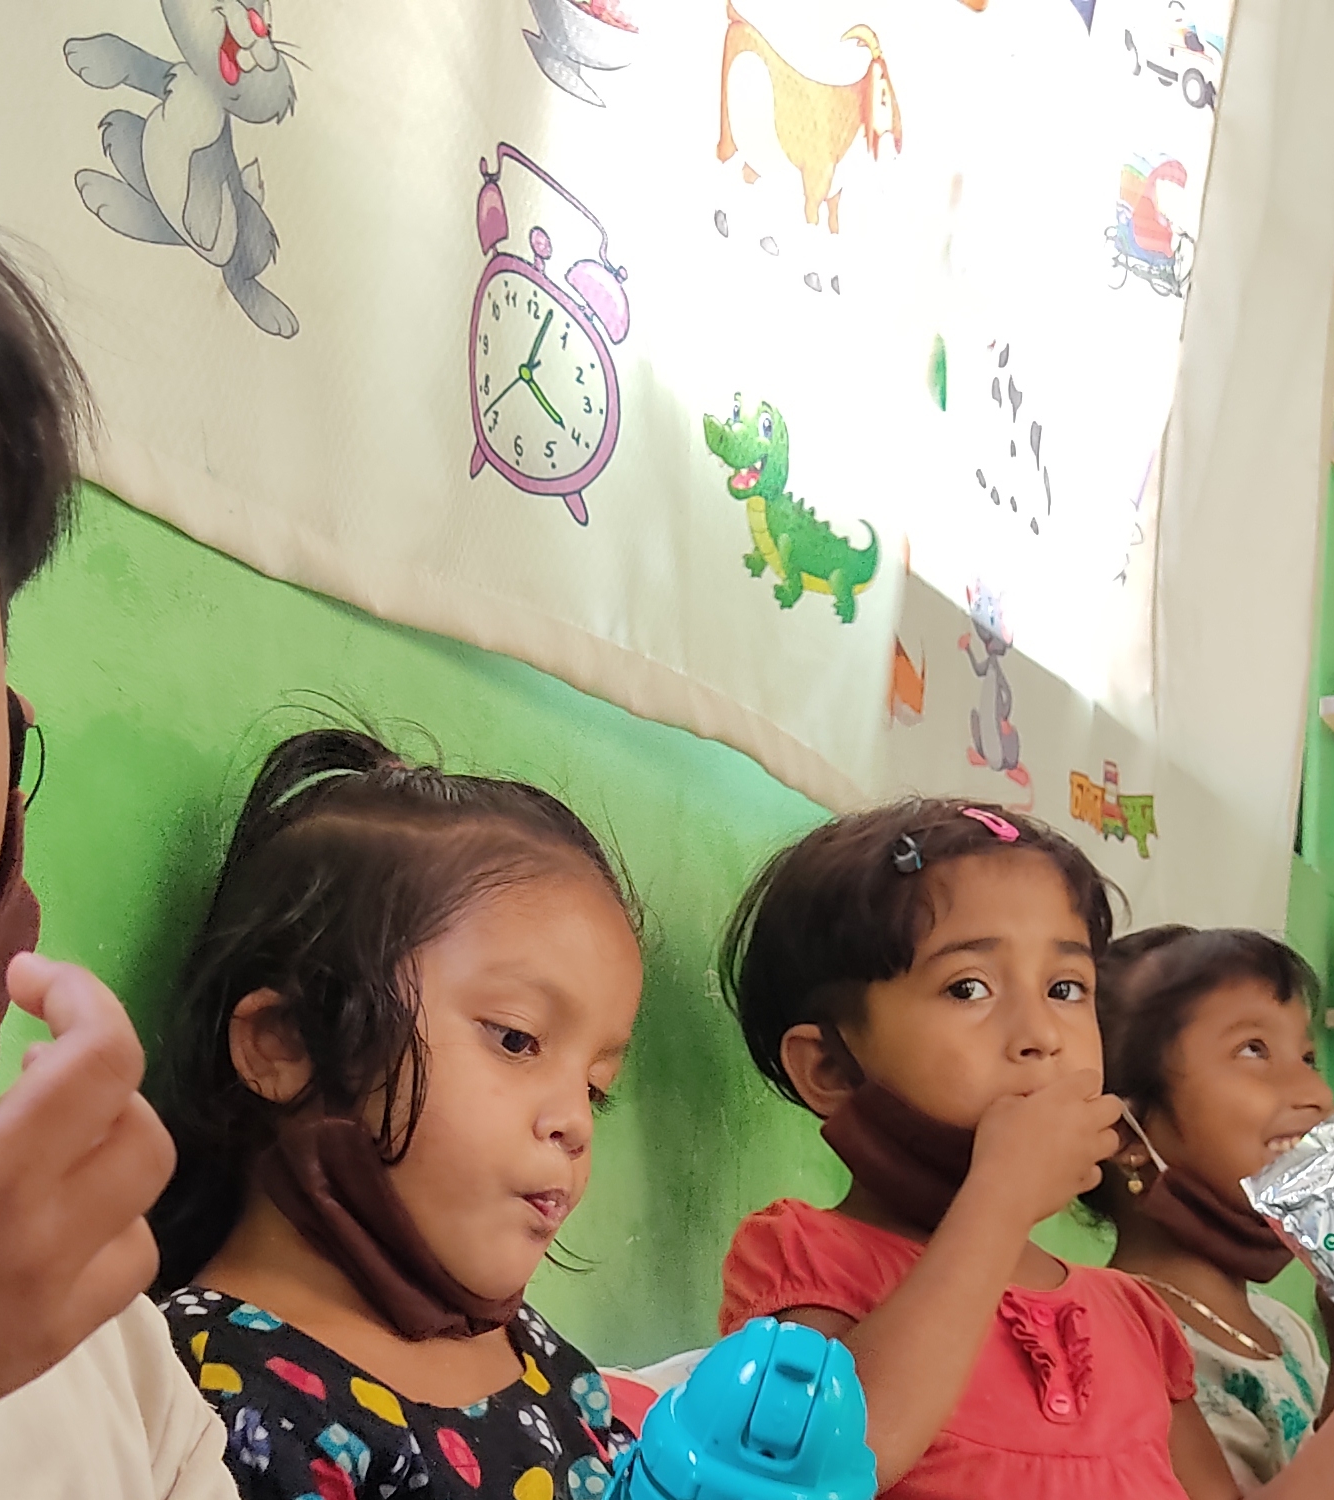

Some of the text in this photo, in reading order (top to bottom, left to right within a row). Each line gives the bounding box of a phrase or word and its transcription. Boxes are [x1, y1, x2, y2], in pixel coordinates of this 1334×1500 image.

[504, 290, 517, 308] 11
[527, 299, 540, 320] 12
[483, 333, 489, 356] 9
[560, 331, 568, 351] 1
[483, 373, 490, 396] 8
[575, 366, 585, 386] 2
[583, 395, 593, 414] 3
[491, 410, 499, 430] 7
[513, 434, 524, 457] 6
[571, 427, 581, 447] 4
[543, 440, 557, 458] 5
